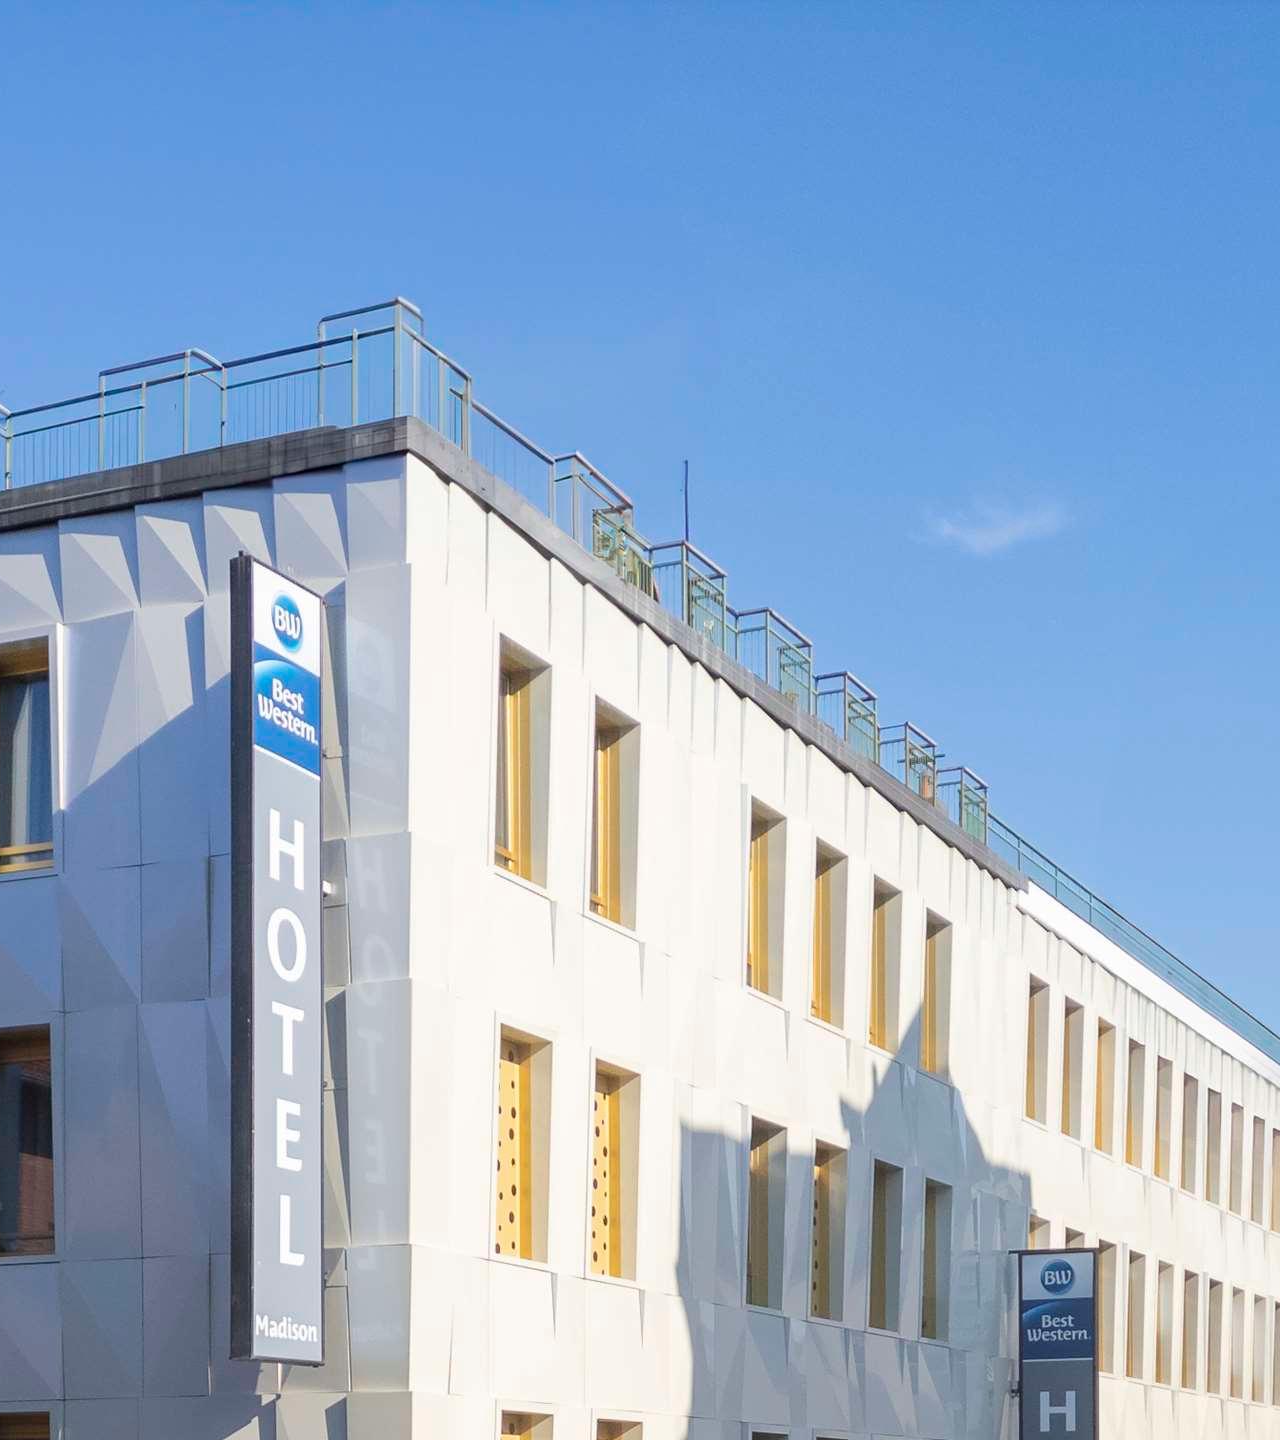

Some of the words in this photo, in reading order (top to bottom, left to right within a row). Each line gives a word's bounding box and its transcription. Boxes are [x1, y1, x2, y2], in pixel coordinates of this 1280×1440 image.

[274, 605, 301, 640] BW
[272, 678, 304, 714] Best
[266, 808, 307, 1266] HOTEL
[1044, 1270, 1072, 1285] BW
[255, 1314, 318, 1342] Madison
[1027, 1329, 1088, 1341] Western
[1041, 1315, 1074, 1328] Best
